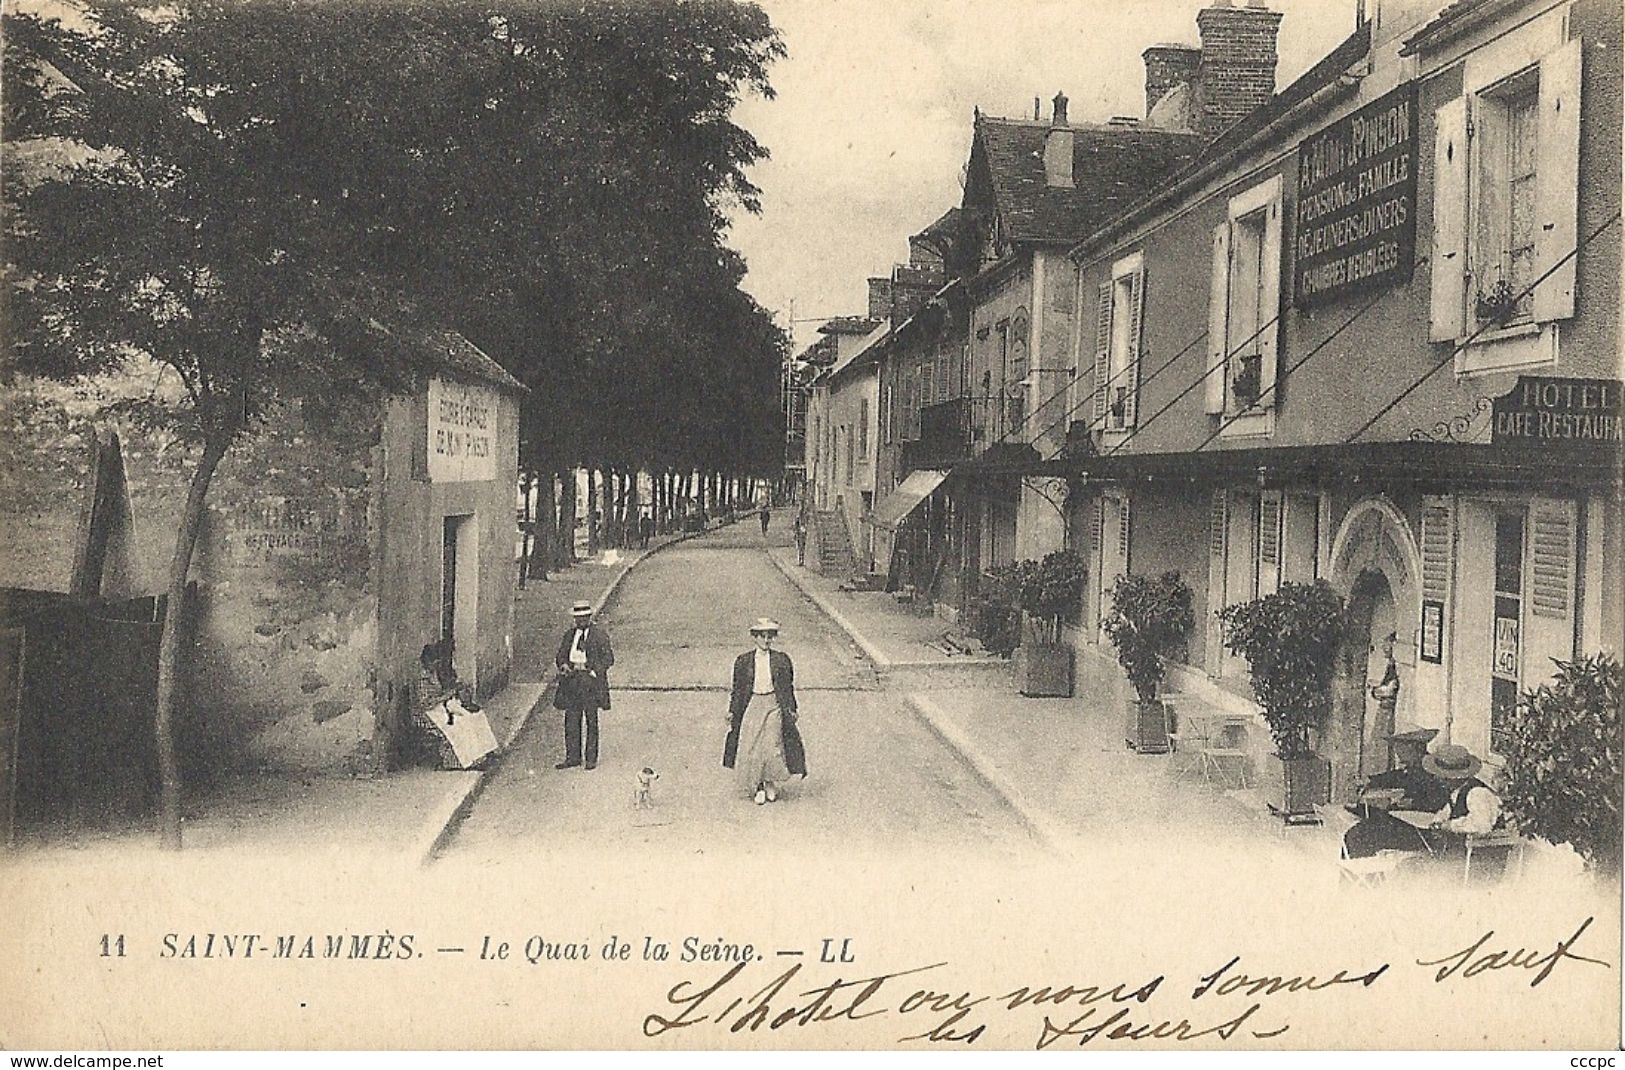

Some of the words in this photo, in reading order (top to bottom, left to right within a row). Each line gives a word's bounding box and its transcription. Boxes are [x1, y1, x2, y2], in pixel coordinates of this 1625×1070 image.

[1301, 181, 1345, 223] PENSION
[1359, 153, 1409, 199] FAMILLE
[1523, 382, 1610, 408] HOTEL
[1499, 619, 1517, 643] VIN
[1500, 651, 1514, 672] 40
[999, 975, 1165, 1011] nous
